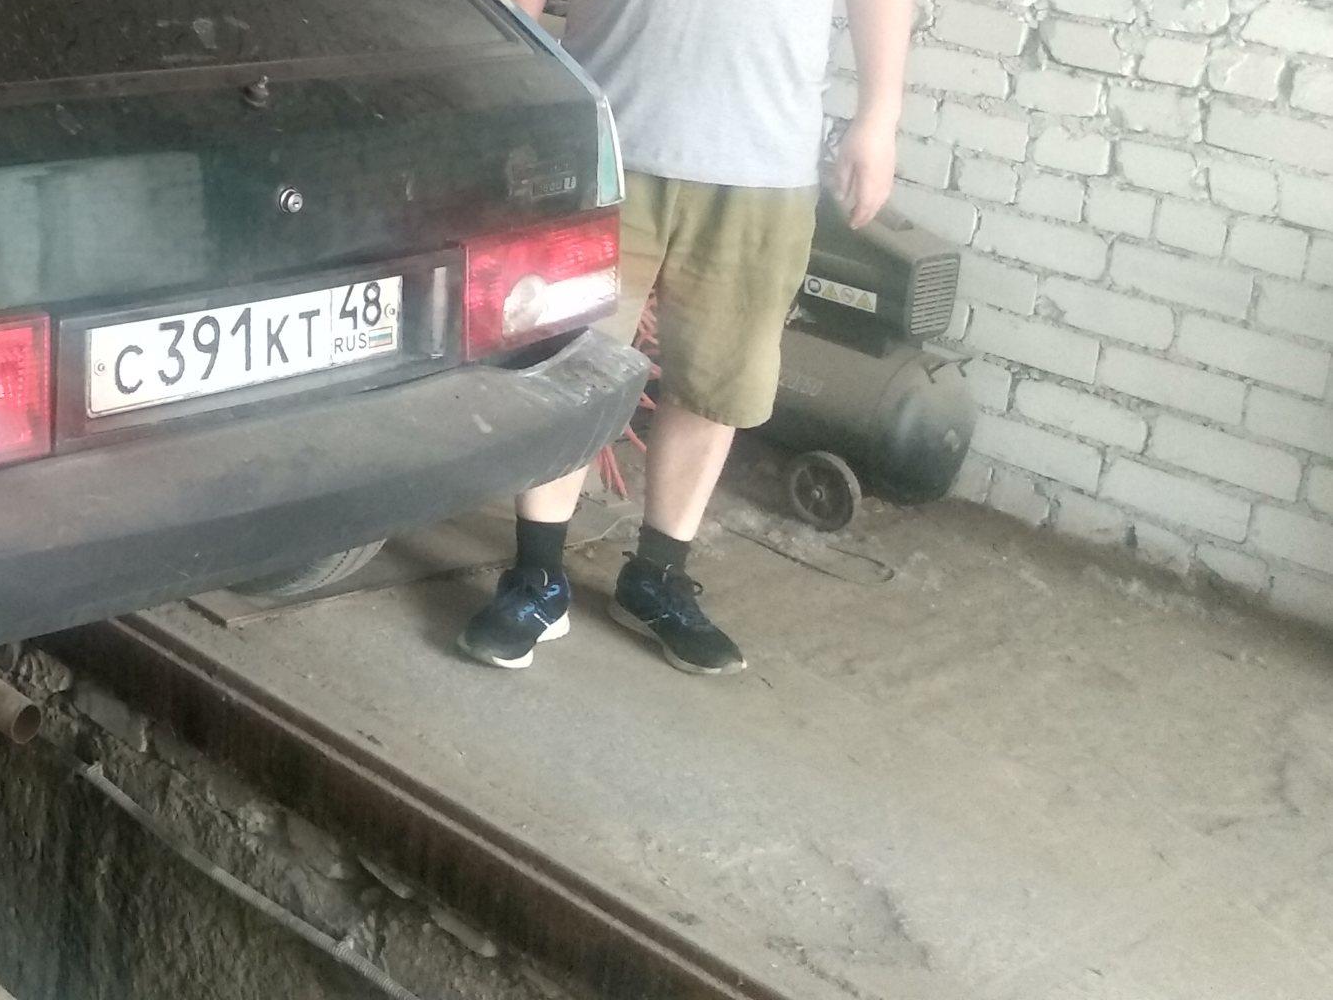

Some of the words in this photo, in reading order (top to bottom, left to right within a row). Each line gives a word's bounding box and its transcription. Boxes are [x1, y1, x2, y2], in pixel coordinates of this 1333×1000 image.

[115, 307, 320, 394] С391КТ
[339, 282, 381, 329] 48
[334, 334, 367, 354] RUS
